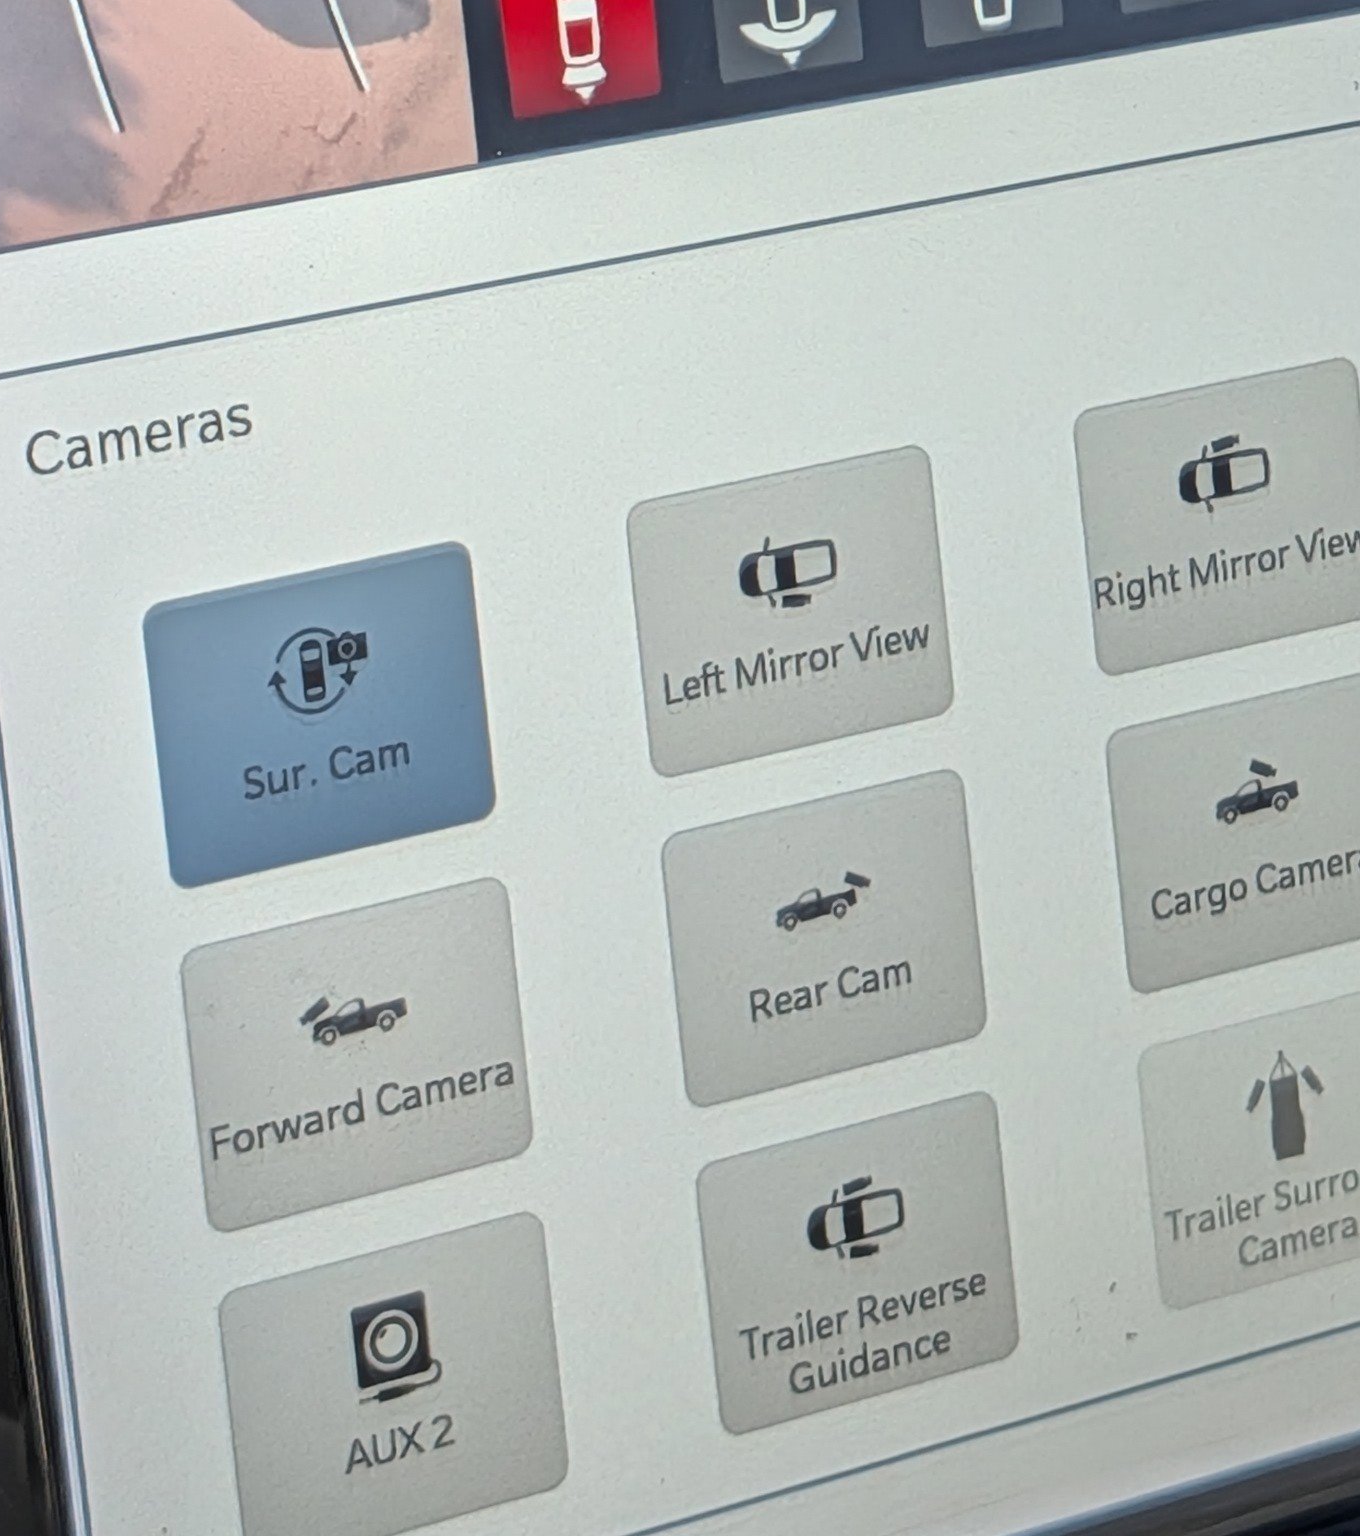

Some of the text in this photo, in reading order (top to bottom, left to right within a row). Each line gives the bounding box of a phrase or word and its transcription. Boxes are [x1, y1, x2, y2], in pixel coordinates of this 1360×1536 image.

[26, 401, 253, 475] Cameras
[1093, 563, 1181, 611] Right
[1188, 540, 1290, 589] Mirror
[662, 622, 930, 706] Left Mirror View
[243, 739, 410, 800] Sur. Cam
[1150, 875, 1248, 922] Cargo
[748, 957, 913, 1023] Rear Cam
[209, 1061, 515, 1162] Forward Camera
[1163, 1194, 1266, 1244] Trailer
[1238, 1215, 1359, 1268] Camera
[738, 1270, 987, 1363] Trailer Reverse
[788, 1329, 952, 1394] Guidance
[345, 1413, 455, 1474] AUX 2
